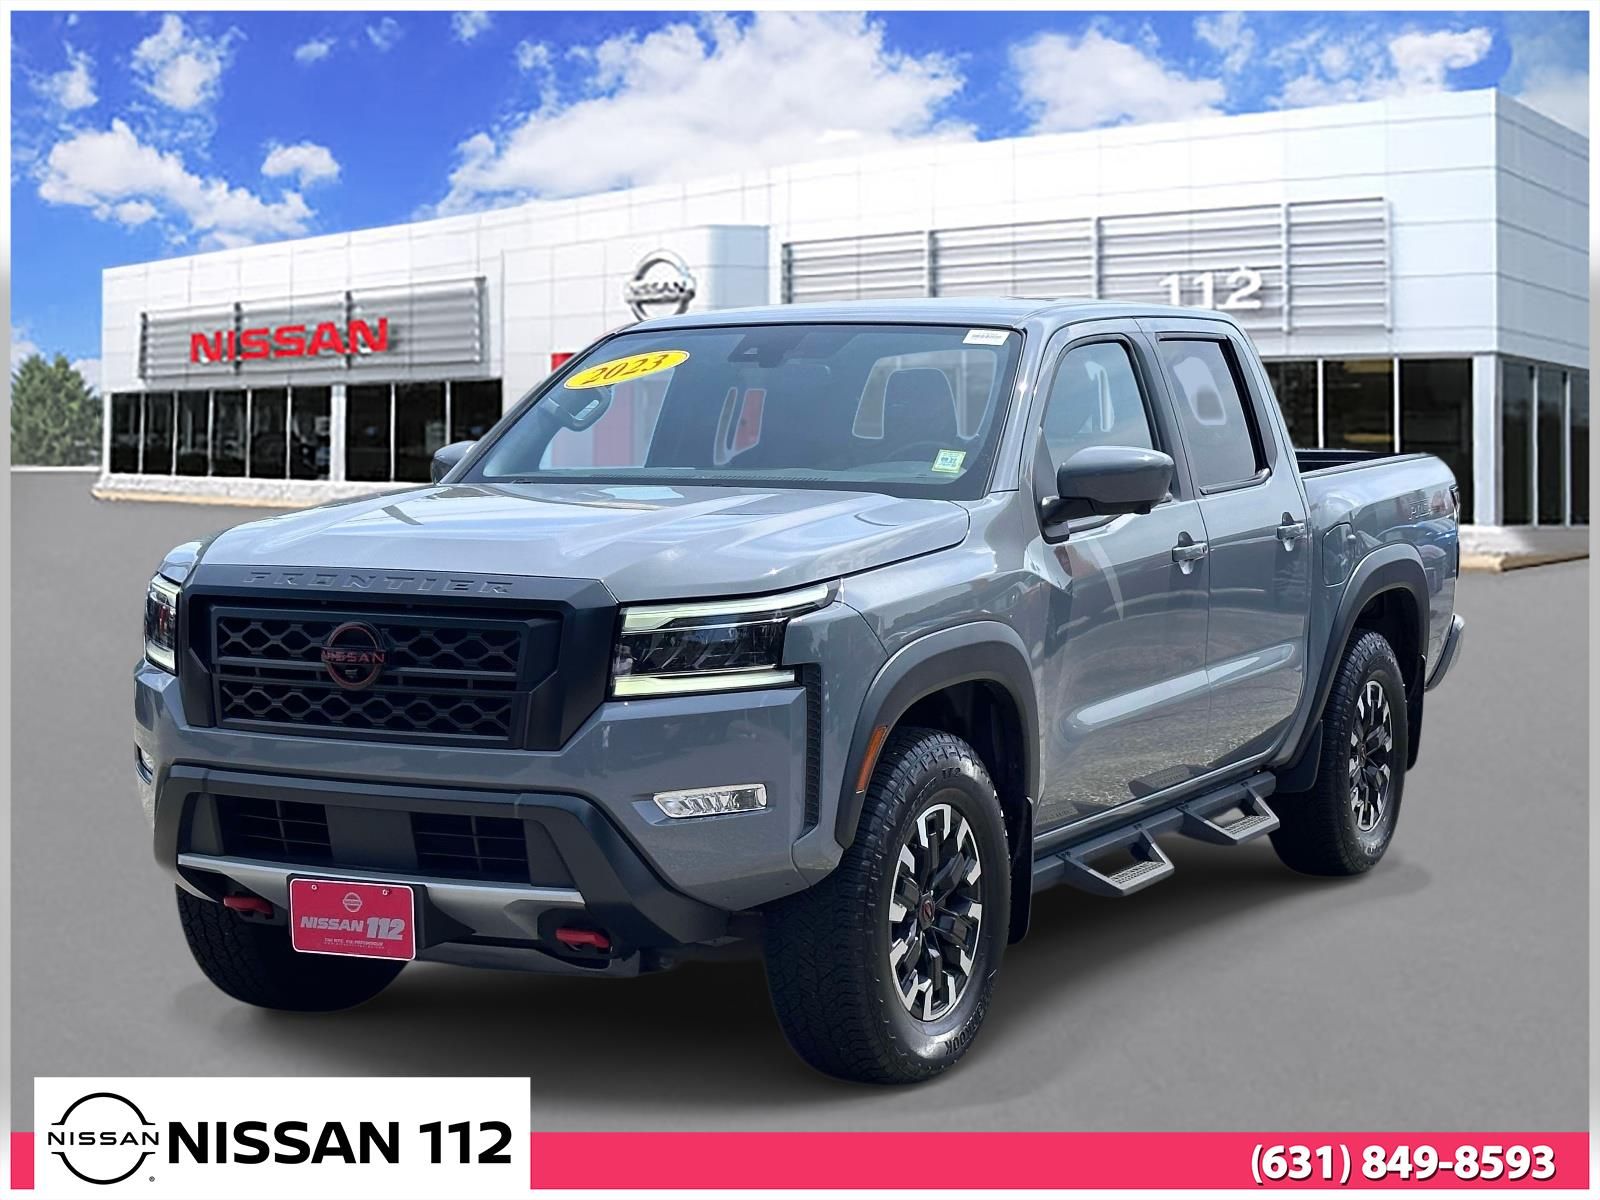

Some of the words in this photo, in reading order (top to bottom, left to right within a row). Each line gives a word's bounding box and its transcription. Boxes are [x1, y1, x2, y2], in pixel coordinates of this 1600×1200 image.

[1159, 268, 1262, 310] 112
[190, 316, 389, 363] NISSAN
[580, 354, 669, 385] 2023
[244, 571, 513, 594] FRONTIER
[321, 650, 385, 663] NISSAN
[300, 916, 364, 932] NISSAN
[366, 916, 406, 941] 112
